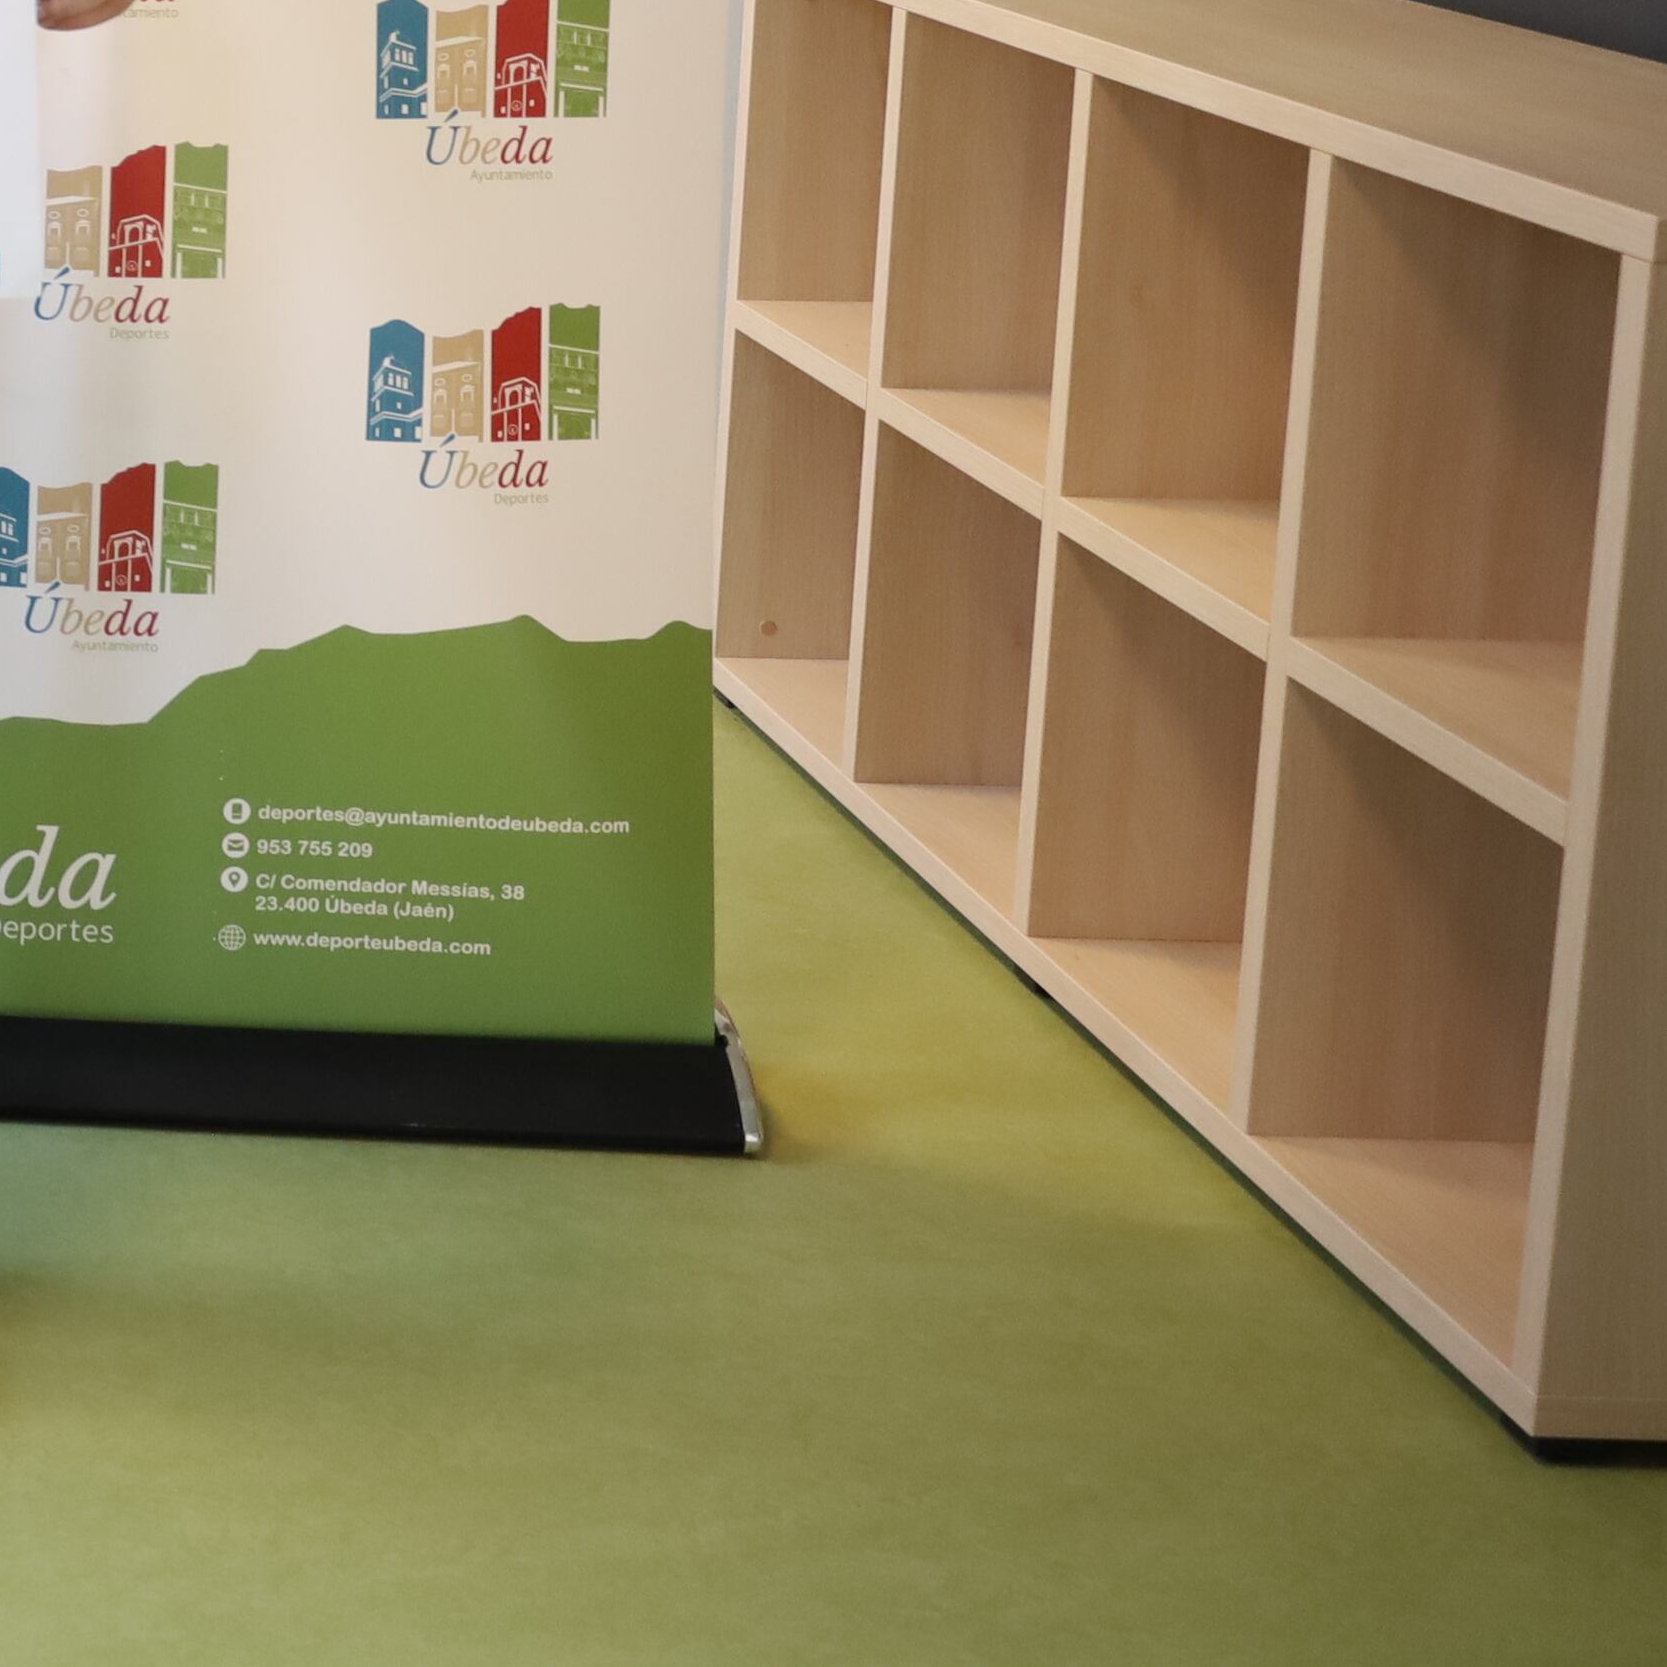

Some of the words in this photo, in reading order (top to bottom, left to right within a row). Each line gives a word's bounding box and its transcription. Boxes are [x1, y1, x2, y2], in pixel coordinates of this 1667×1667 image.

[425, 109, 553, 167] Úbeda
[470, 168, 553, 182] Ayuntamiento
[34, 265, 170, 325] Úbeda
[109, 327, 170, 340] Deportes
[419, 432, 550, 490] Úbeda
[493, 492, 550, 506] Deportes
[24, 581, 159, 637] Úbeda
[71, 639, 158, 653] Ayuntamiento
[258, 805, 629, 835] deportes@ayuntamientodeubeda.com
[257, 839, 291, 855] 953
[298, 840, 332, 856] 755
[338, 842, 373, 858] 209
[256, 874, 277, 890] C/
[281, 874, 407, 895] Comendador
[411, 879, 495, 901] Messías,
[501, 884, 525, 900] 38
[255, 897, 320, 913] 23.400
[325, 896, 388, 916] Úbeda
[393, 901, 454, 922] (Jaén)
[253, 932, 492, 956] www.deporteubeda.com
